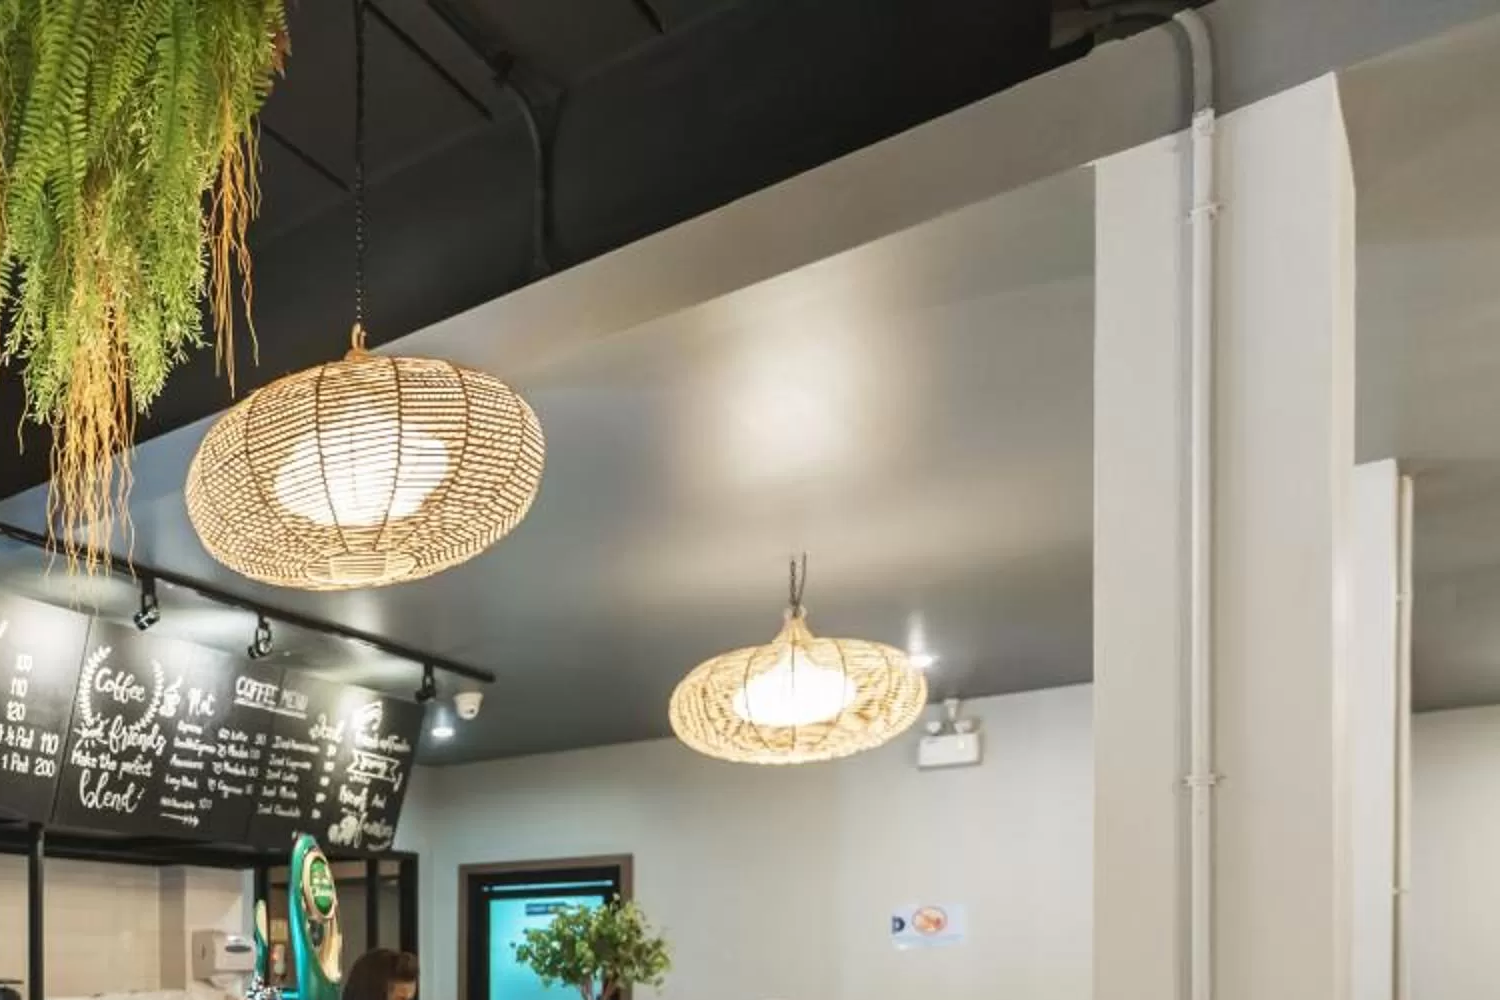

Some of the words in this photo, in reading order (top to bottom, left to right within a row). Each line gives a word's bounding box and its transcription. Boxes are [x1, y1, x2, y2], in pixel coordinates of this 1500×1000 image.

[95, 667, 145, 703] Coffee
[236, 676, 278, 705] COFFEE
[109, 715, 167, 756] friends
[34, 757, 56, 777] 200
